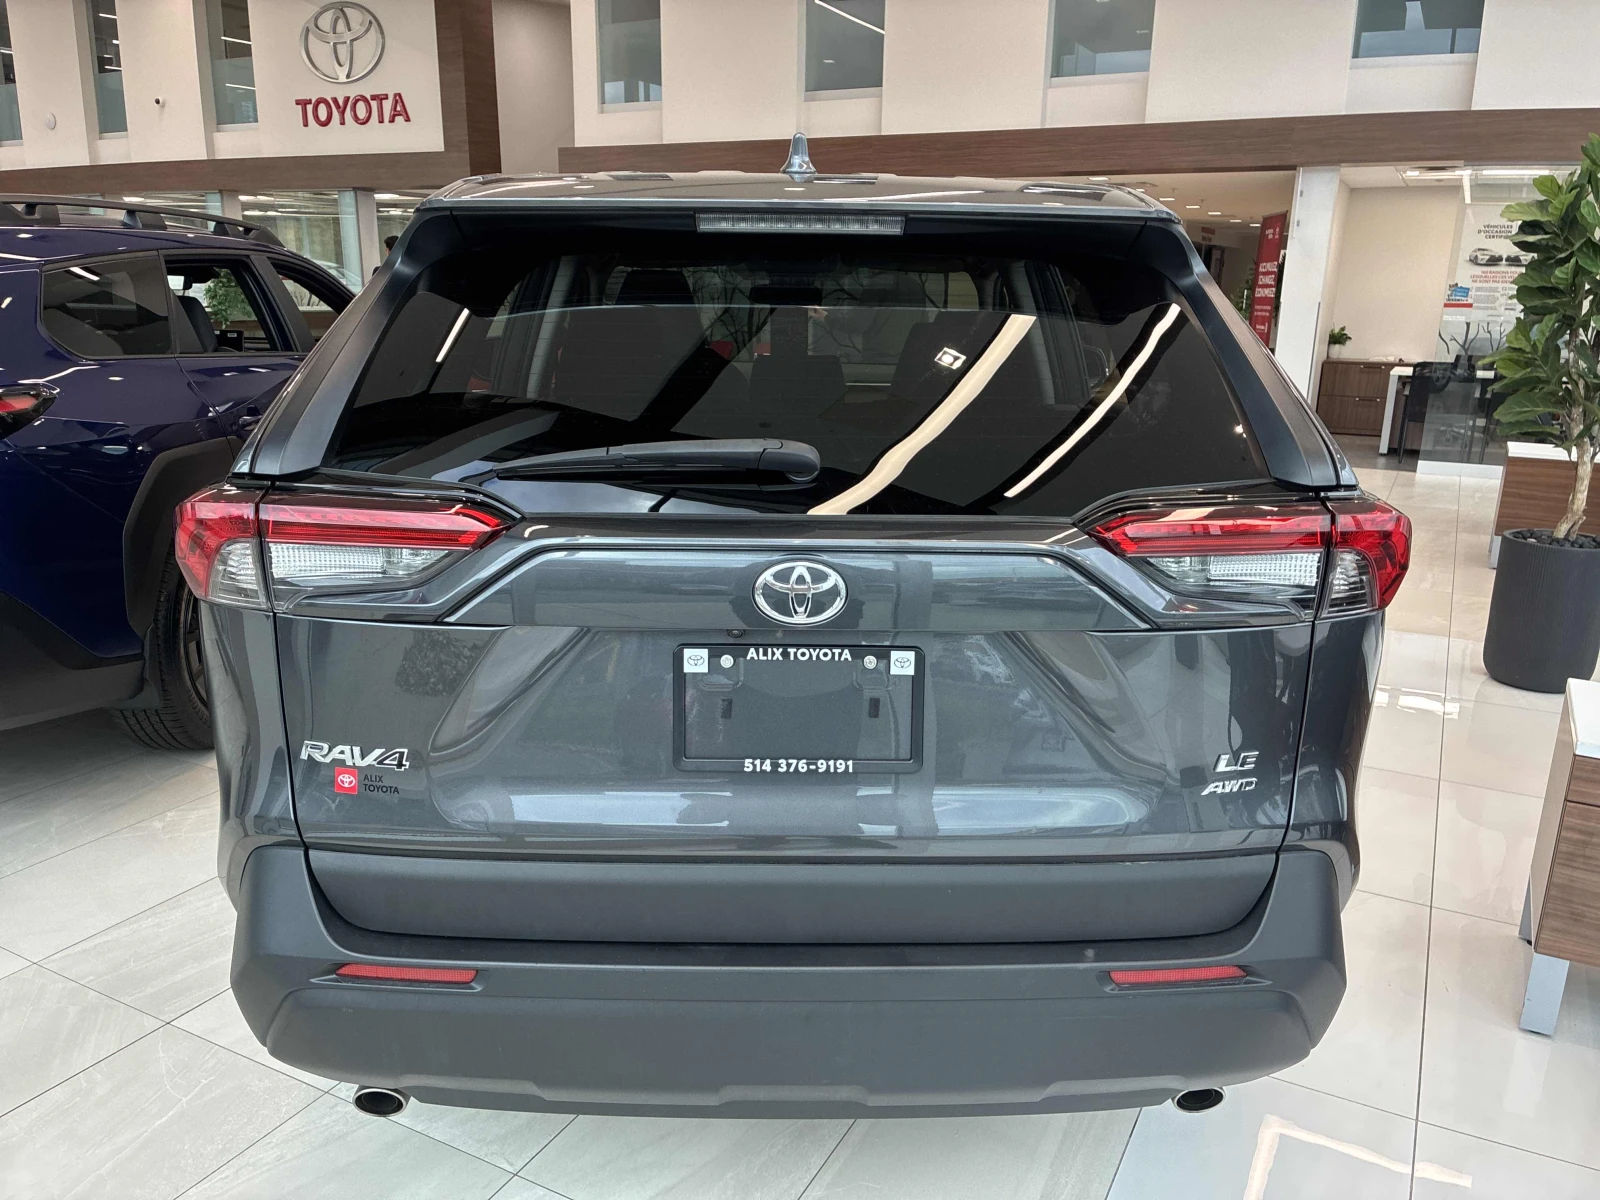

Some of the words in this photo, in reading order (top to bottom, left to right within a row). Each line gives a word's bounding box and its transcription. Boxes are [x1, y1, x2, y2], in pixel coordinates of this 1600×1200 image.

[295, 92, 411, 127] TOYOTA
[746, 648, 783, 660] ALIX
[787, 649, 852, 661] TOYOTA
[300, 740, 410, 771] RAV4
[1213, 751, 1259, 772] LE
[743, 759, 772, 772] 514
[778, 759, 853, 773] 376-9191
[363, 774, 384, 783] ALIX
[1200, 777, 1258, 796] AWD
[363, 783, 400, 794] TOYOTA
